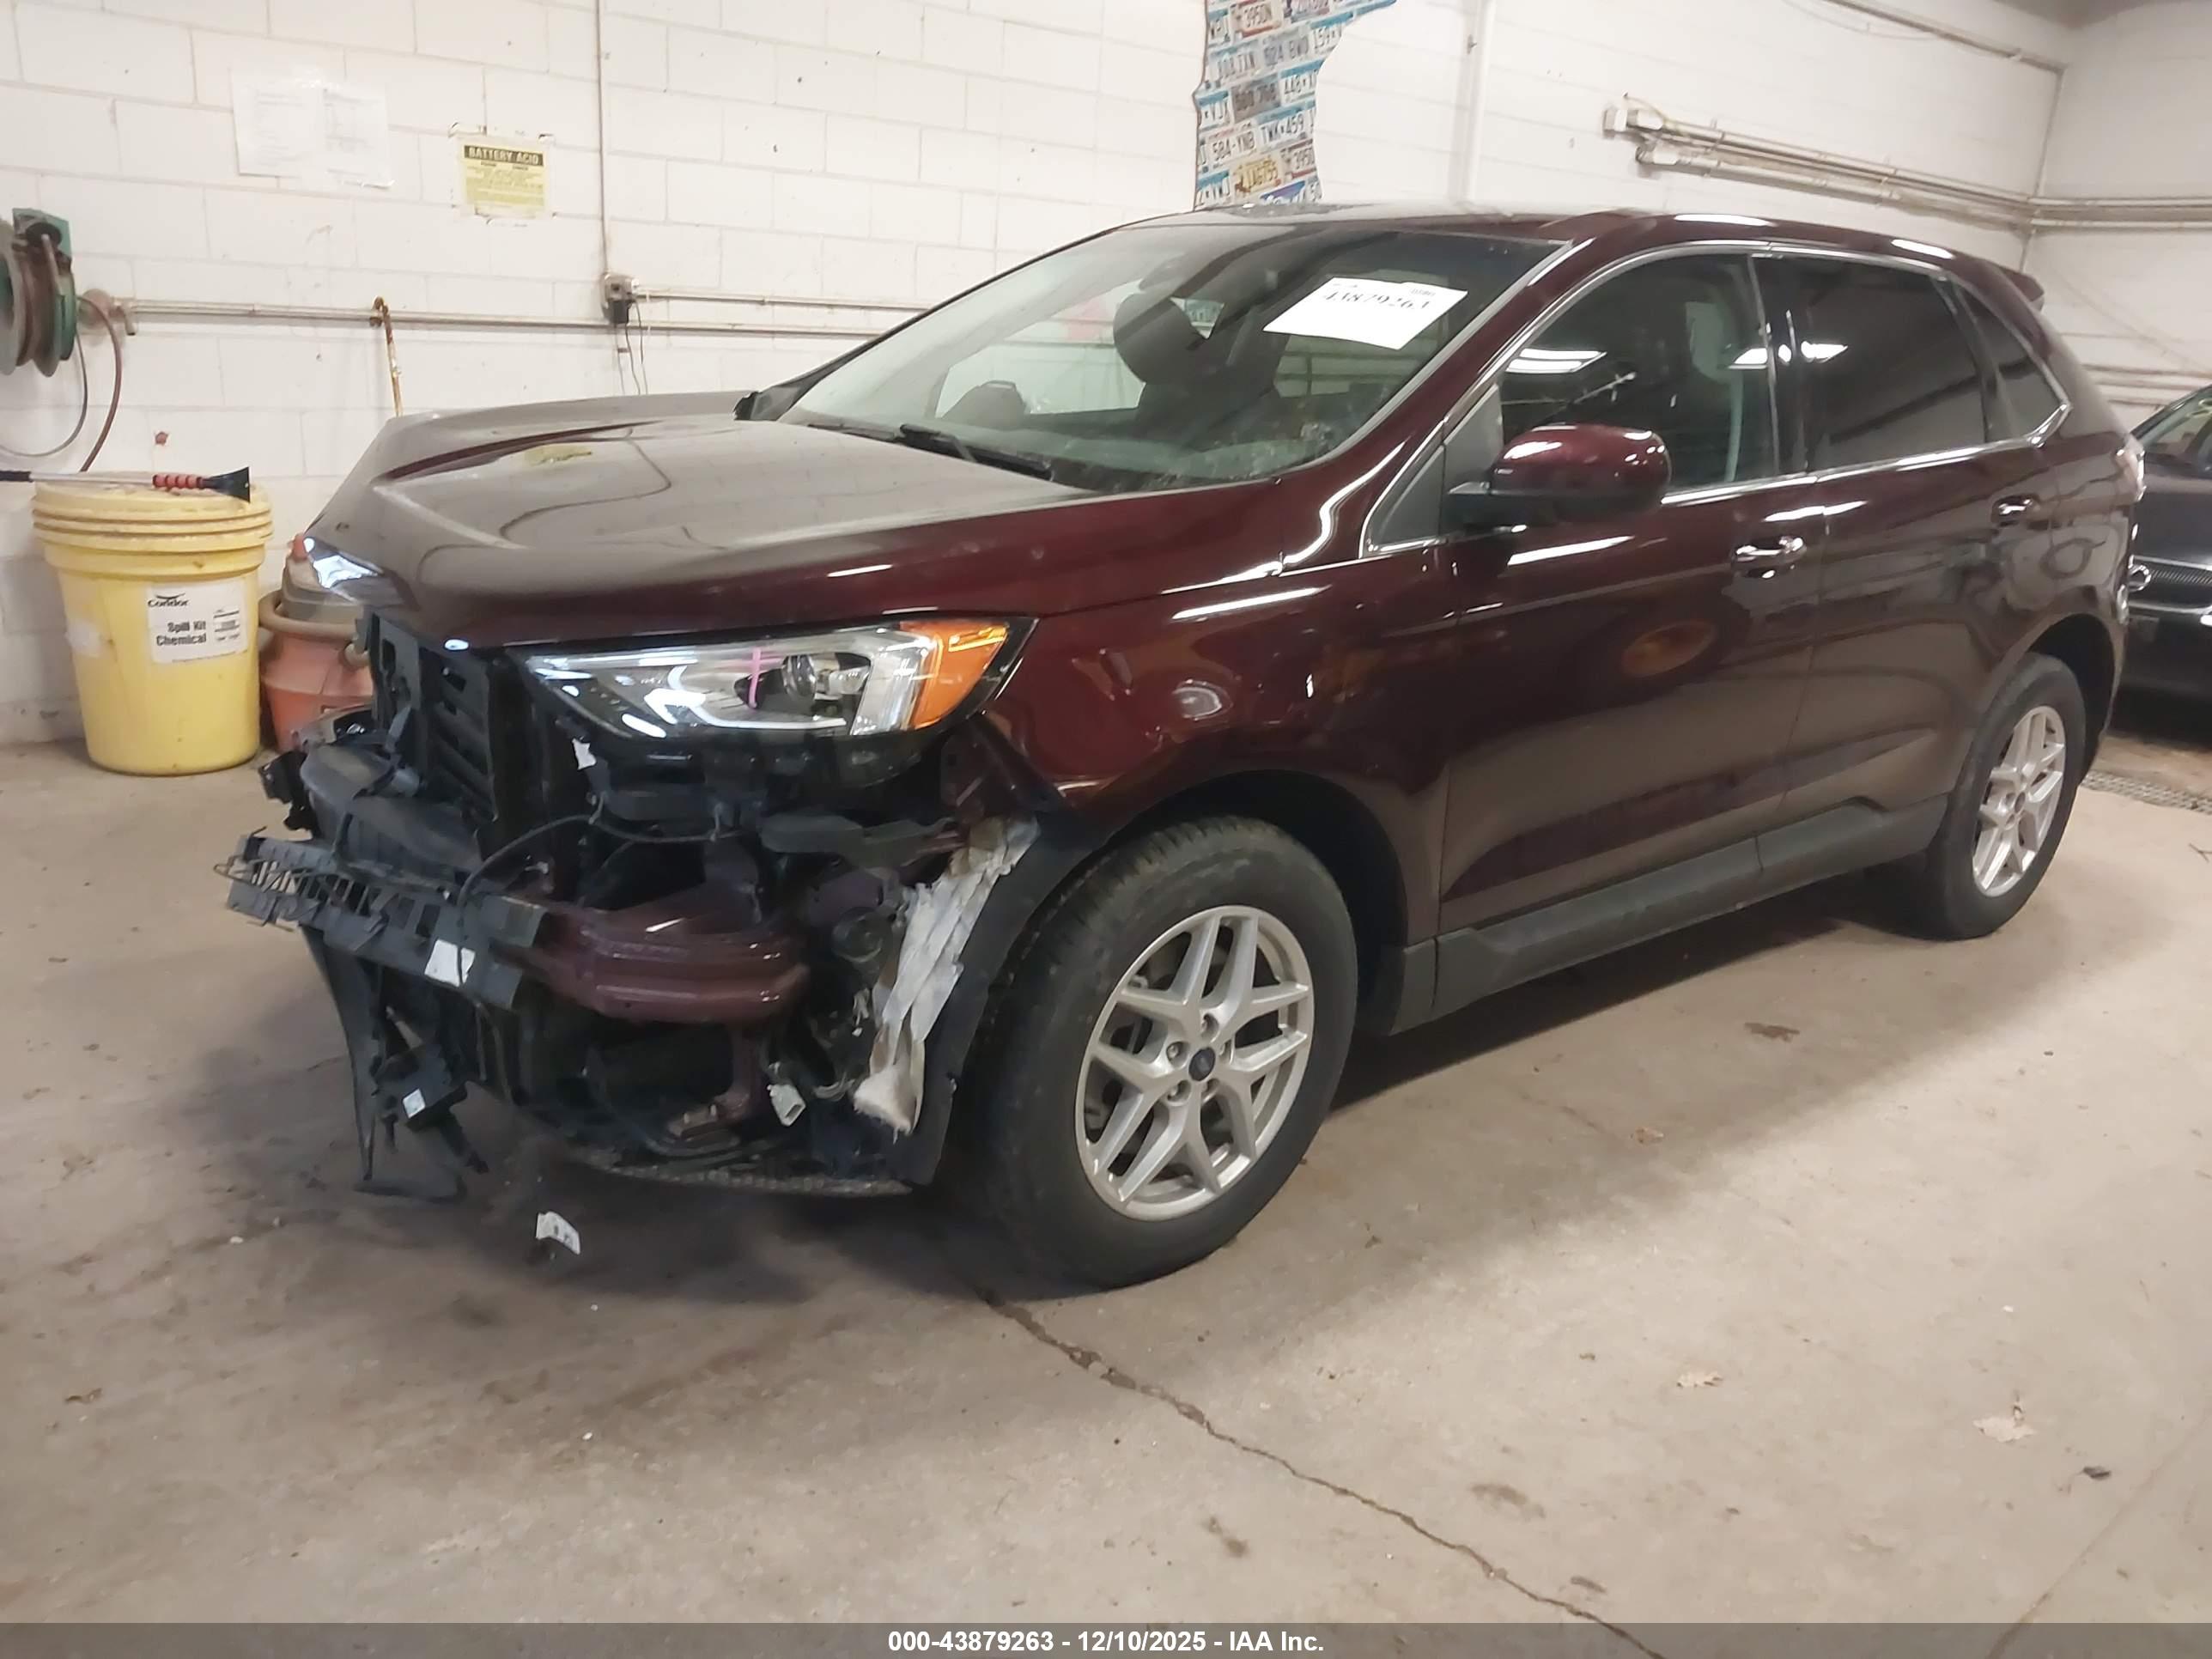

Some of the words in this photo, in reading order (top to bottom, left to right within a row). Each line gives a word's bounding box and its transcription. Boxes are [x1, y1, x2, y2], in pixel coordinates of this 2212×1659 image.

[468, 146, 513, 162] BATTERY
[516, 152, 539, 165] ACID
[147, 599, 189, 608] Condor
[167, 621, 190, 633] Spill
[193, 620, 206, 631] Kit
[156, 633, 207, 647] Chemical
